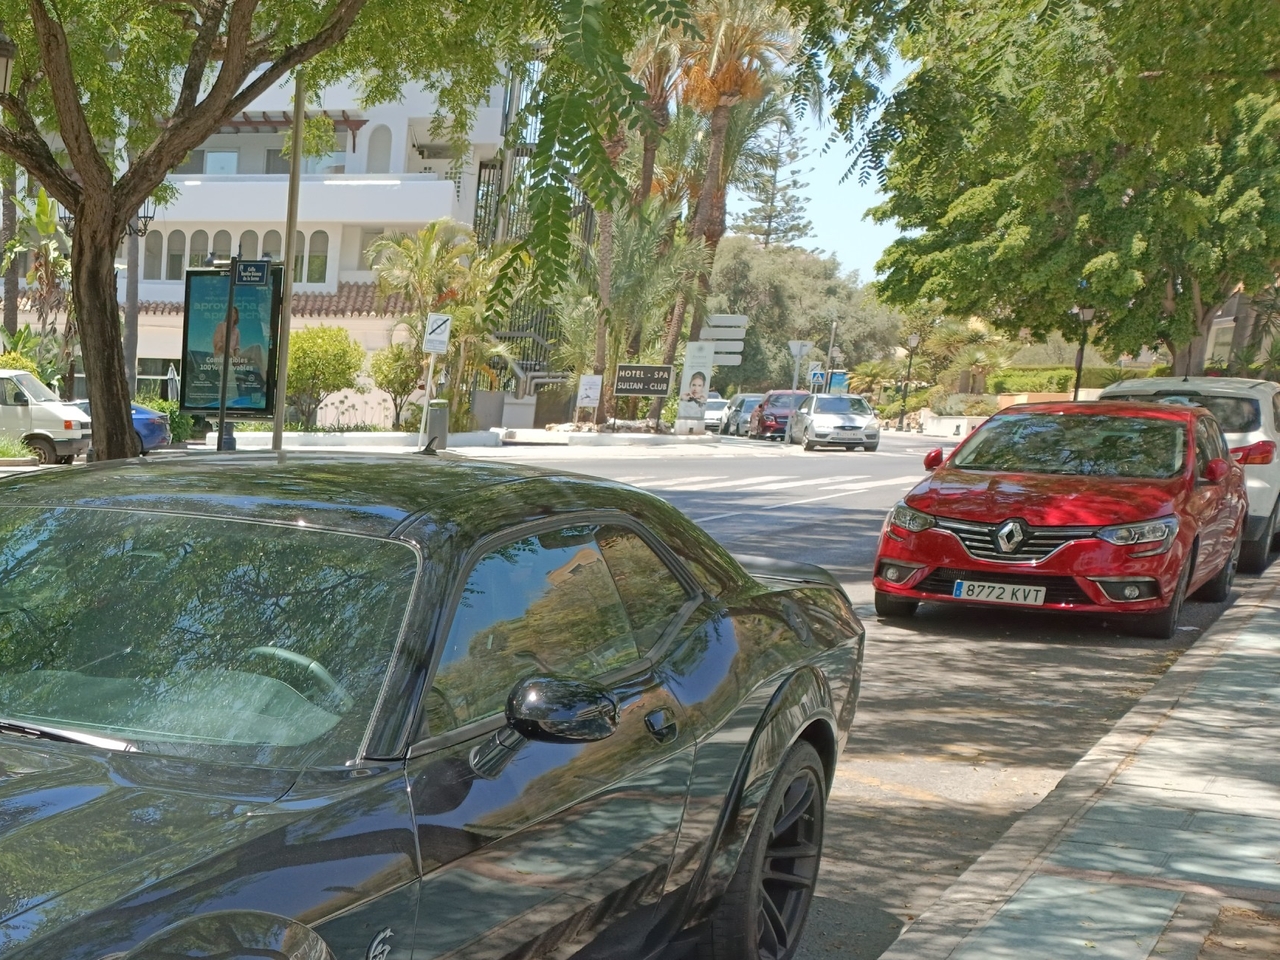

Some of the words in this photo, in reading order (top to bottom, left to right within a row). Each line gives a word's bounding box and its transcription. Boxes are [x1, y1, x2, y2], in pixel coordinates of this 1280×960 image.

[193, 301, 258, 311] aprovcha
[619, 370, 645, 378] HOTEL
[654, 371, 669, 379] SPA
[617, 382, 643, 390] SULTAN
[966, 584, 1006, 600] 8772
[1010, 588, 1042, 603] KVT
